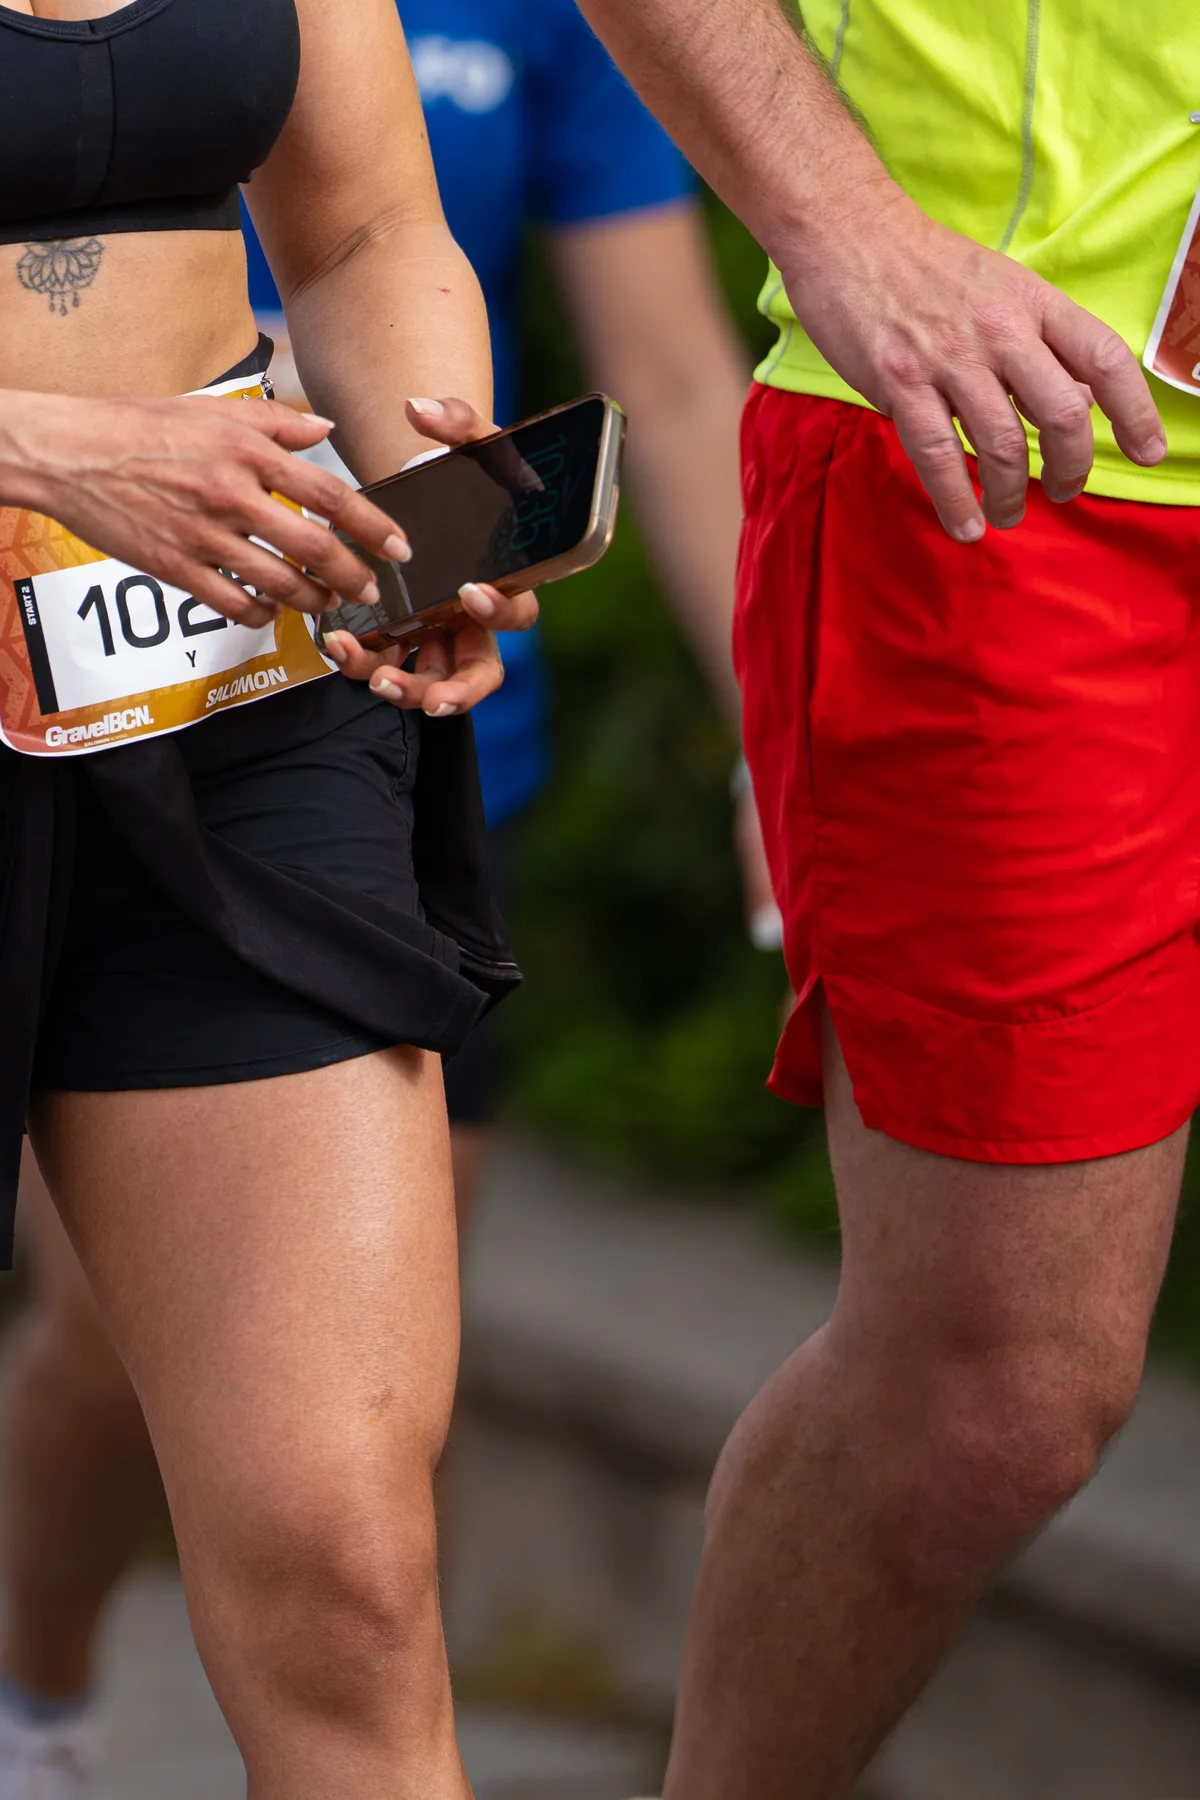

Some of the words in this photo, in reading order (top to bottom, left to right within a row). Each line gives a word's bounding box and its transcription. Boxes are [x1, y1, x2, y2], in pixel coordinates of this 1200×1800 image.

[21, 585, 31, 594] 2
[22, 594, 37, 626] START
[184, 650, 197, 668] Y
[205, 666, 289, 709] SALOMON
[45, 704, 155, 748] GravelBCN.
